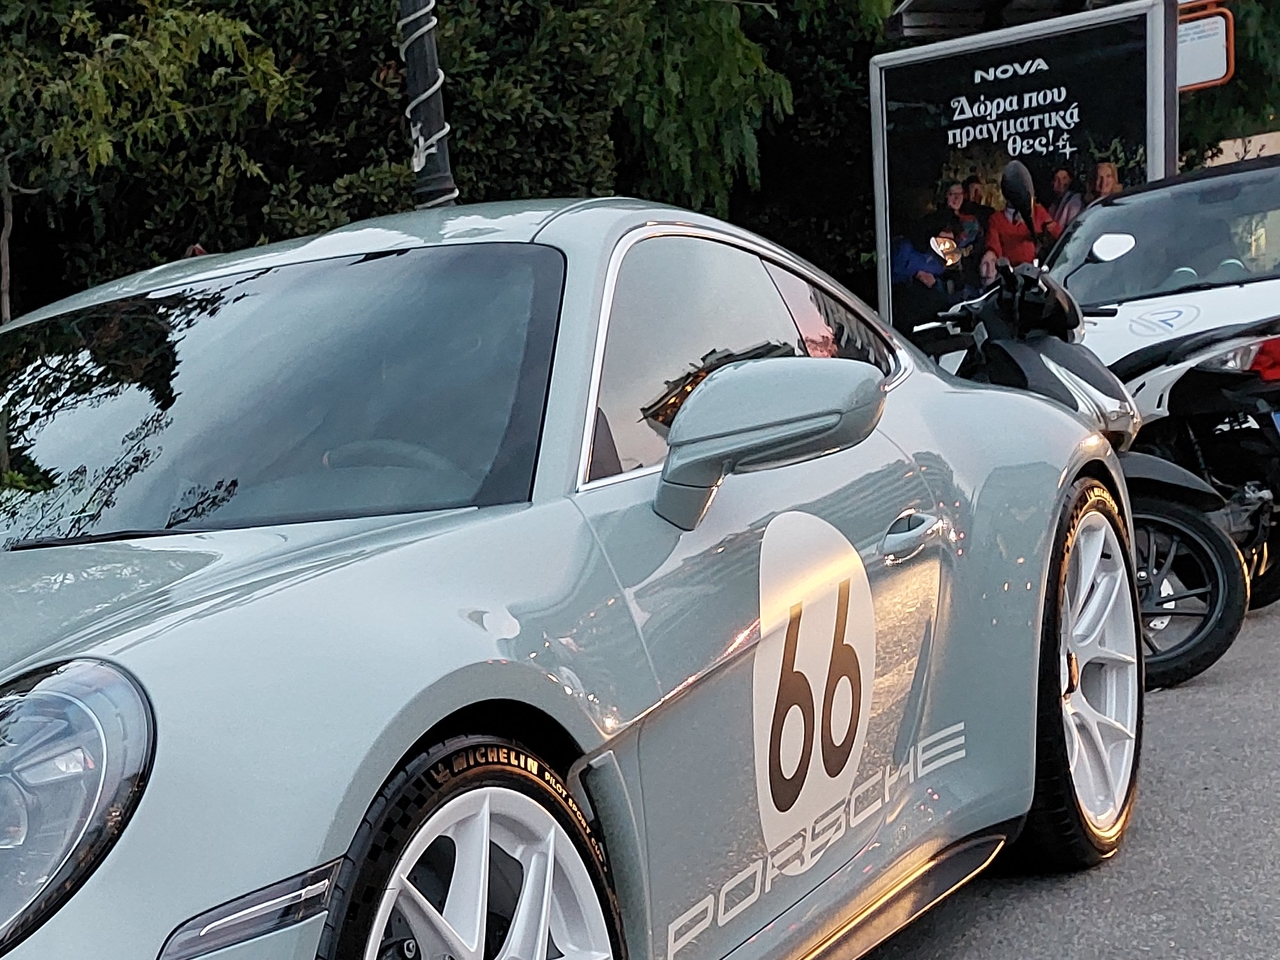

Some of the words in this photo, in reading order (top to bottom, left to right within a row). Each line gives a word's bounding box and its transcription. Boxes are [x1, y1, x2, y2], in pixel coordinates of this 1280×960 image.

[974, 58, 1050, 84] NOVA
[950, 94, 1019, 121] Δώρα
[1023, 86, 1067, 109] που
[947, 102, 1080, 149] πραγματικά
[1007, 129, 1054, 157] θες!
[768, 578, 862, 814] 66
[452, 747, 539, 776] MICHELIN
[544, 771, 568, 799] PILOT
[568, 798, 592, 834] SPORT
